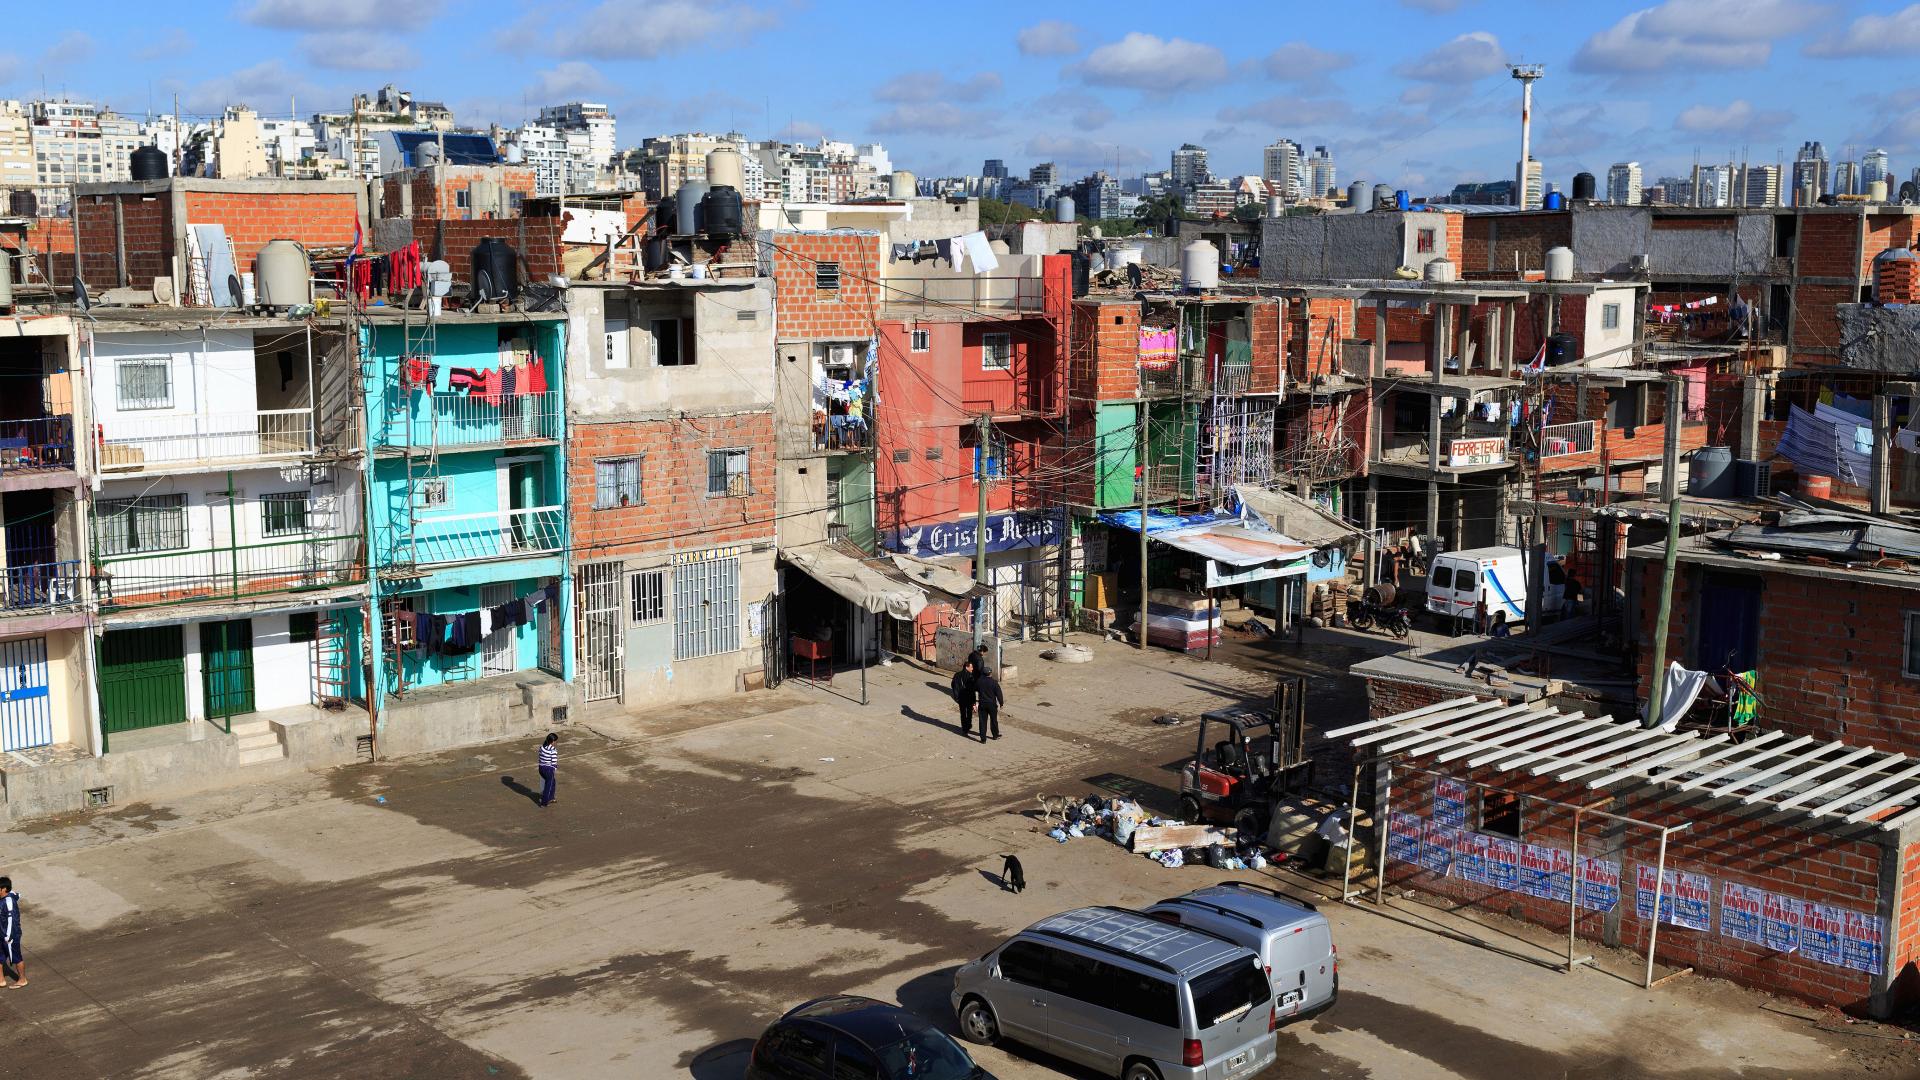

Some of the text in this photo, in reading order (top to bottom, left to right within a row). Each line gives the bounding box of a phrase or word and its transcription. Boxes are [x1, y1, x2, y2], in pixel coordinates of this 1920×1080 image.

[1452, 439, 1505, 456] FERRETERIA
[930, 524, 993, 551] Cristo
[1520, 855, 1550, 872] MAYO
[1586, 869, 1617, 886] MAYO
[1676, 884, 1709, 902] MAYO
[1724, 895, 1759, 913] MAYO
[1763, 906, 1799, 925] MAYO
[1803, 915, 1840, 934] MAYO
[1844, 924, 1882, 944] MAYO
